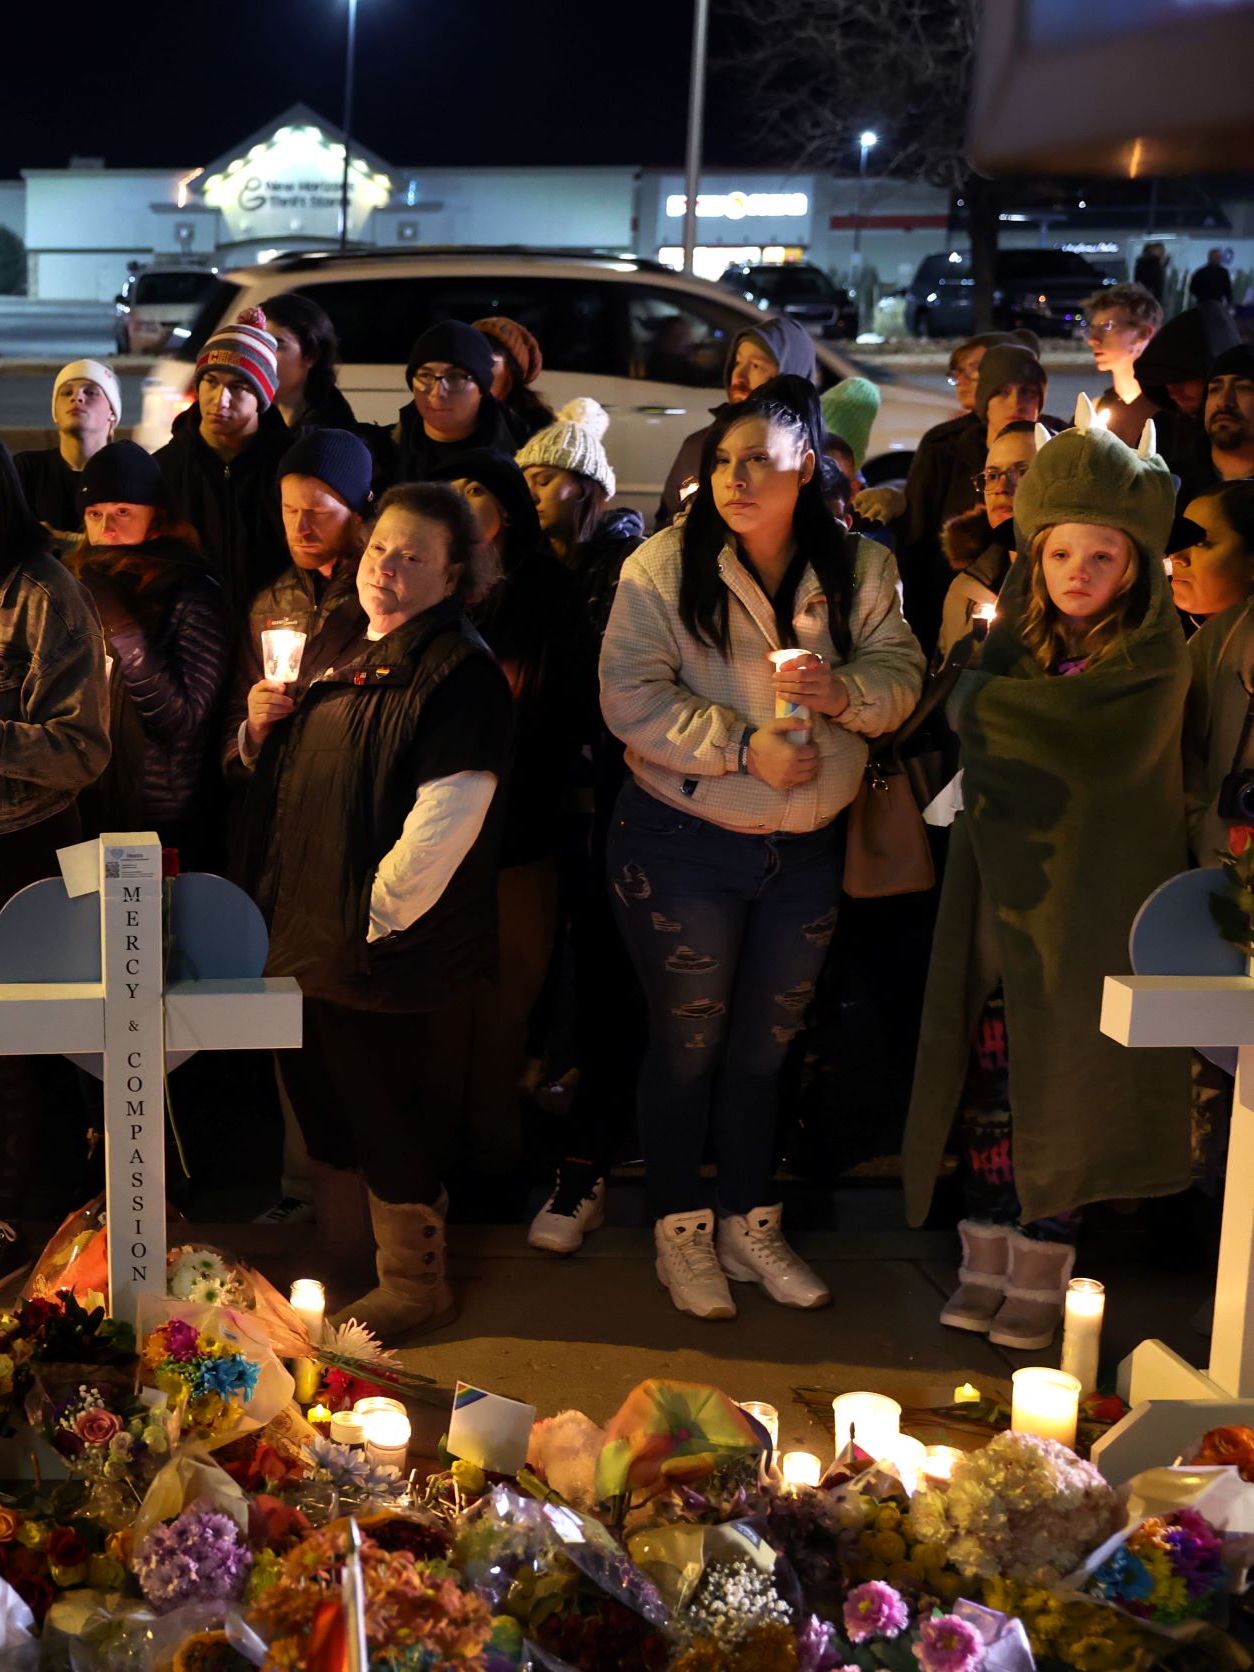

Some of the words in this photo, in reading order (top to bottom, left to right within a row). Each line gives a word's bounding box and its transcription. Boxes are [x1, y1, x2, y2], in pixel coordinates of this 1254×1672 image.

[122, 886, 142, 999] MERCY
[128, 1020, 139, 1032] &
[125, 1052, 147, 1281] COMPASSION
